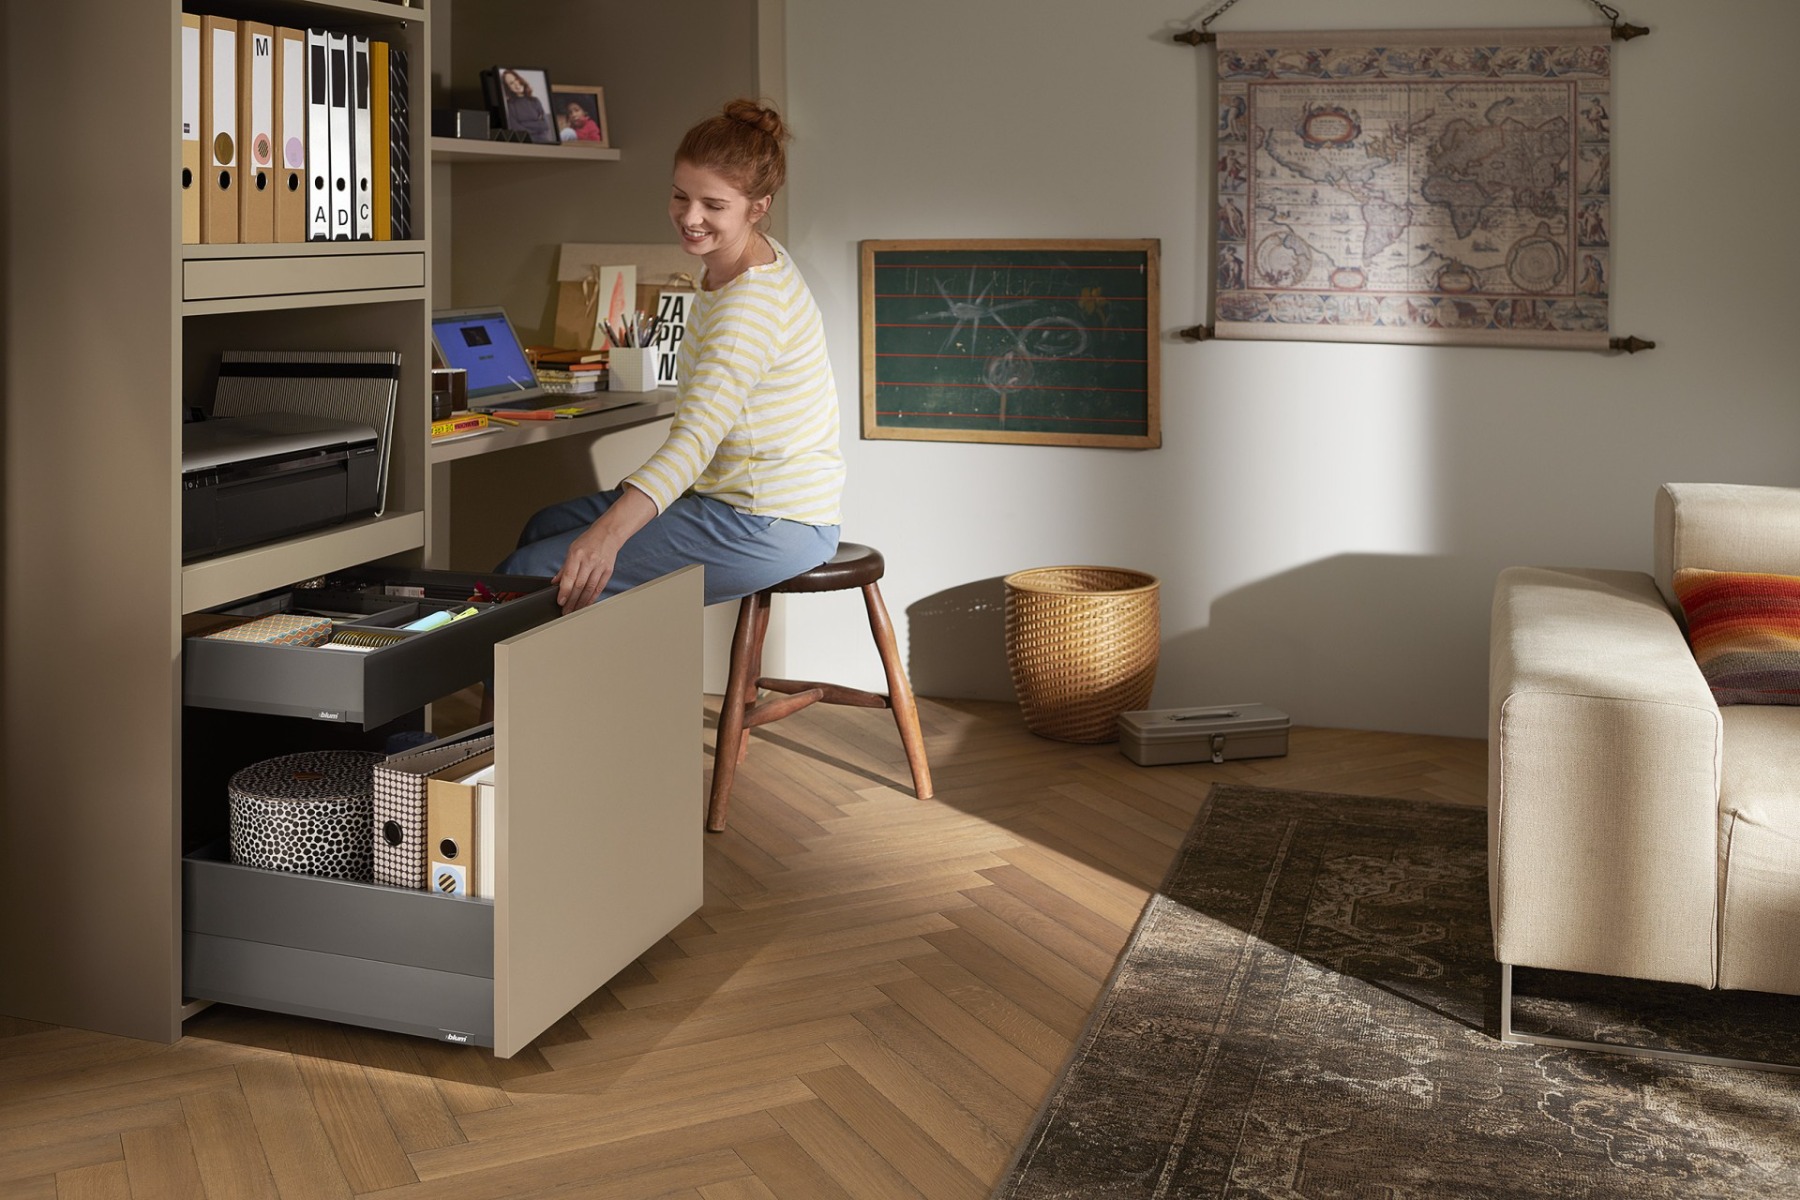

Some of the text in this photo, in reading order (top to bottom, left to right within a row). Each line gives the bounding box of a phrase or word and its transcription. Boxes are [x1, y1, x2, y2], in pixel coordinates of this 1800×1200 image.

[256, 38, 269, 56] M
[314, 206, 327, 223] A
[338, 210, 349, 226] D
[360, 204, 369, 220] C
[660, 296, 684, 323] ZA
[320, 711, 340, 720] blum
[447, 1033, 468, 1043] blum
